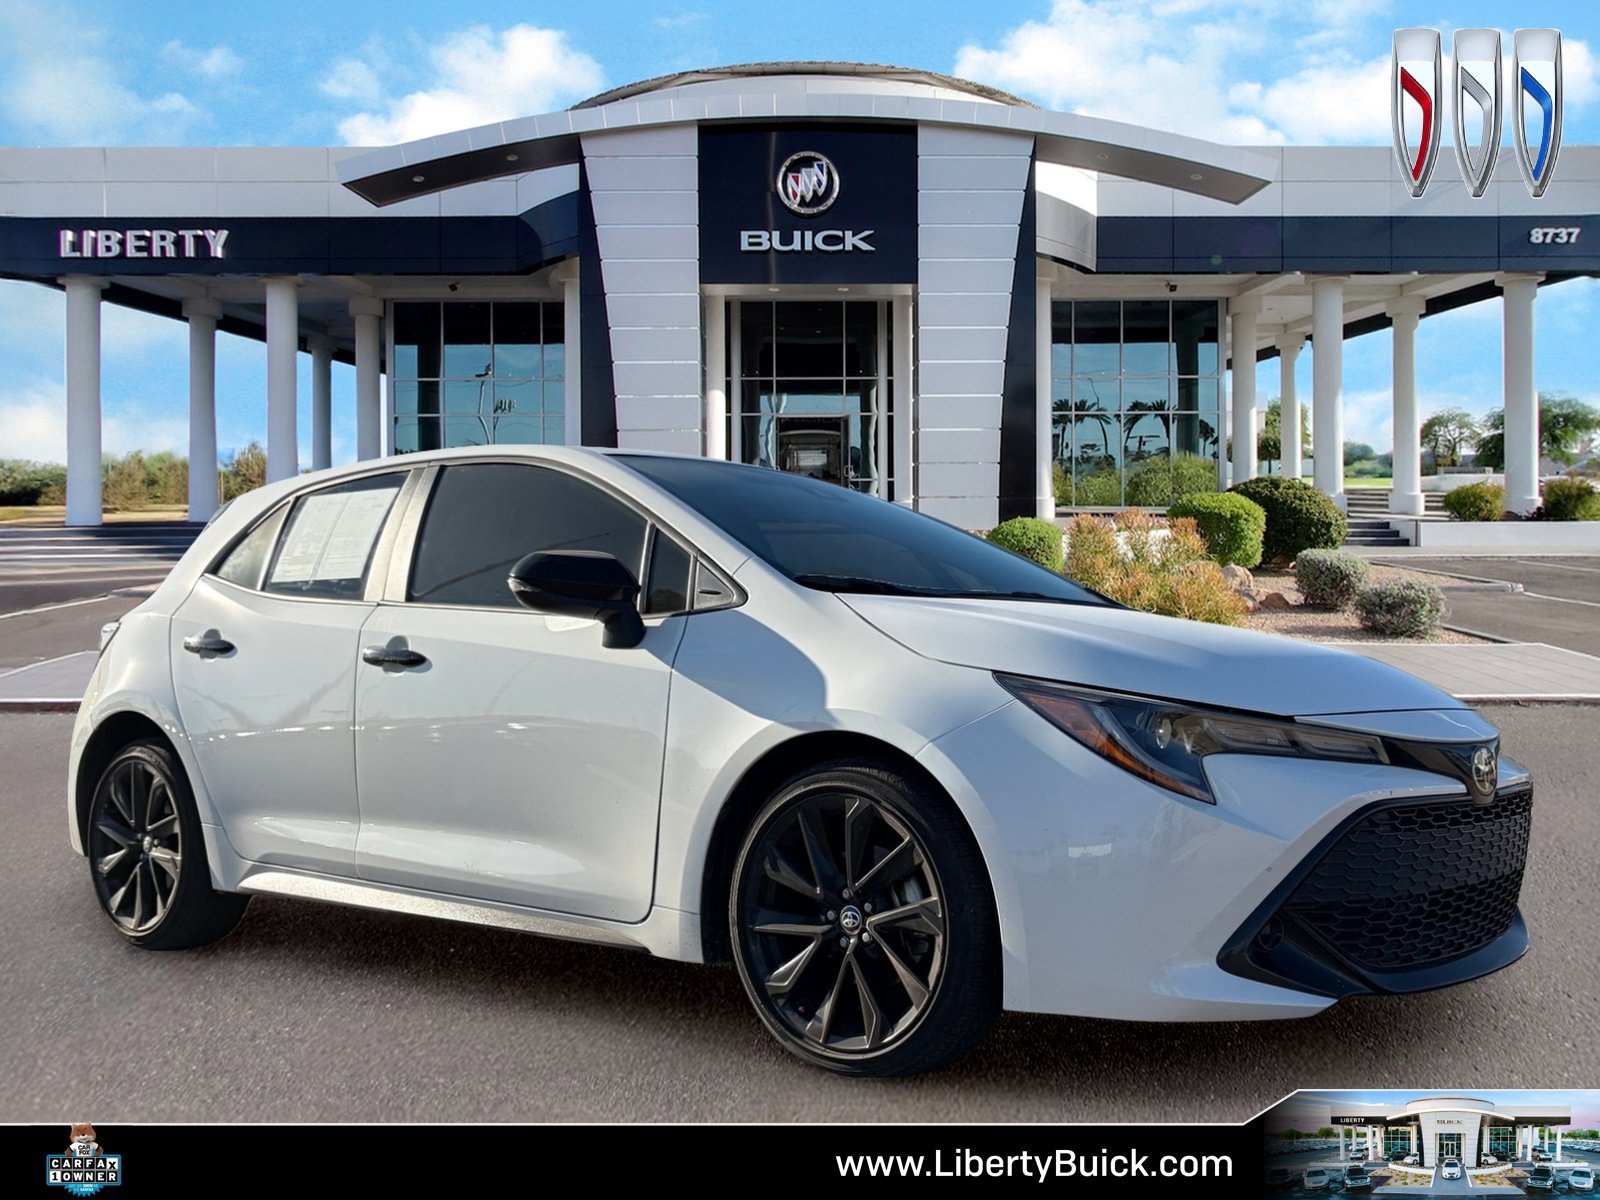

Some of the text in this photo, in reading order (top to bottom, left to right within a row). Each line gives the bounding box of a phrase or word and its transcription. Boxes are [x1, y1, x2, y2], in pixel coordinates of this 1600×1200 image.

[59, 229, 229, 258] LIBERTY
[740, 230, 876, 251] BUICK
[1529, 227, 1581, 244] 8737
